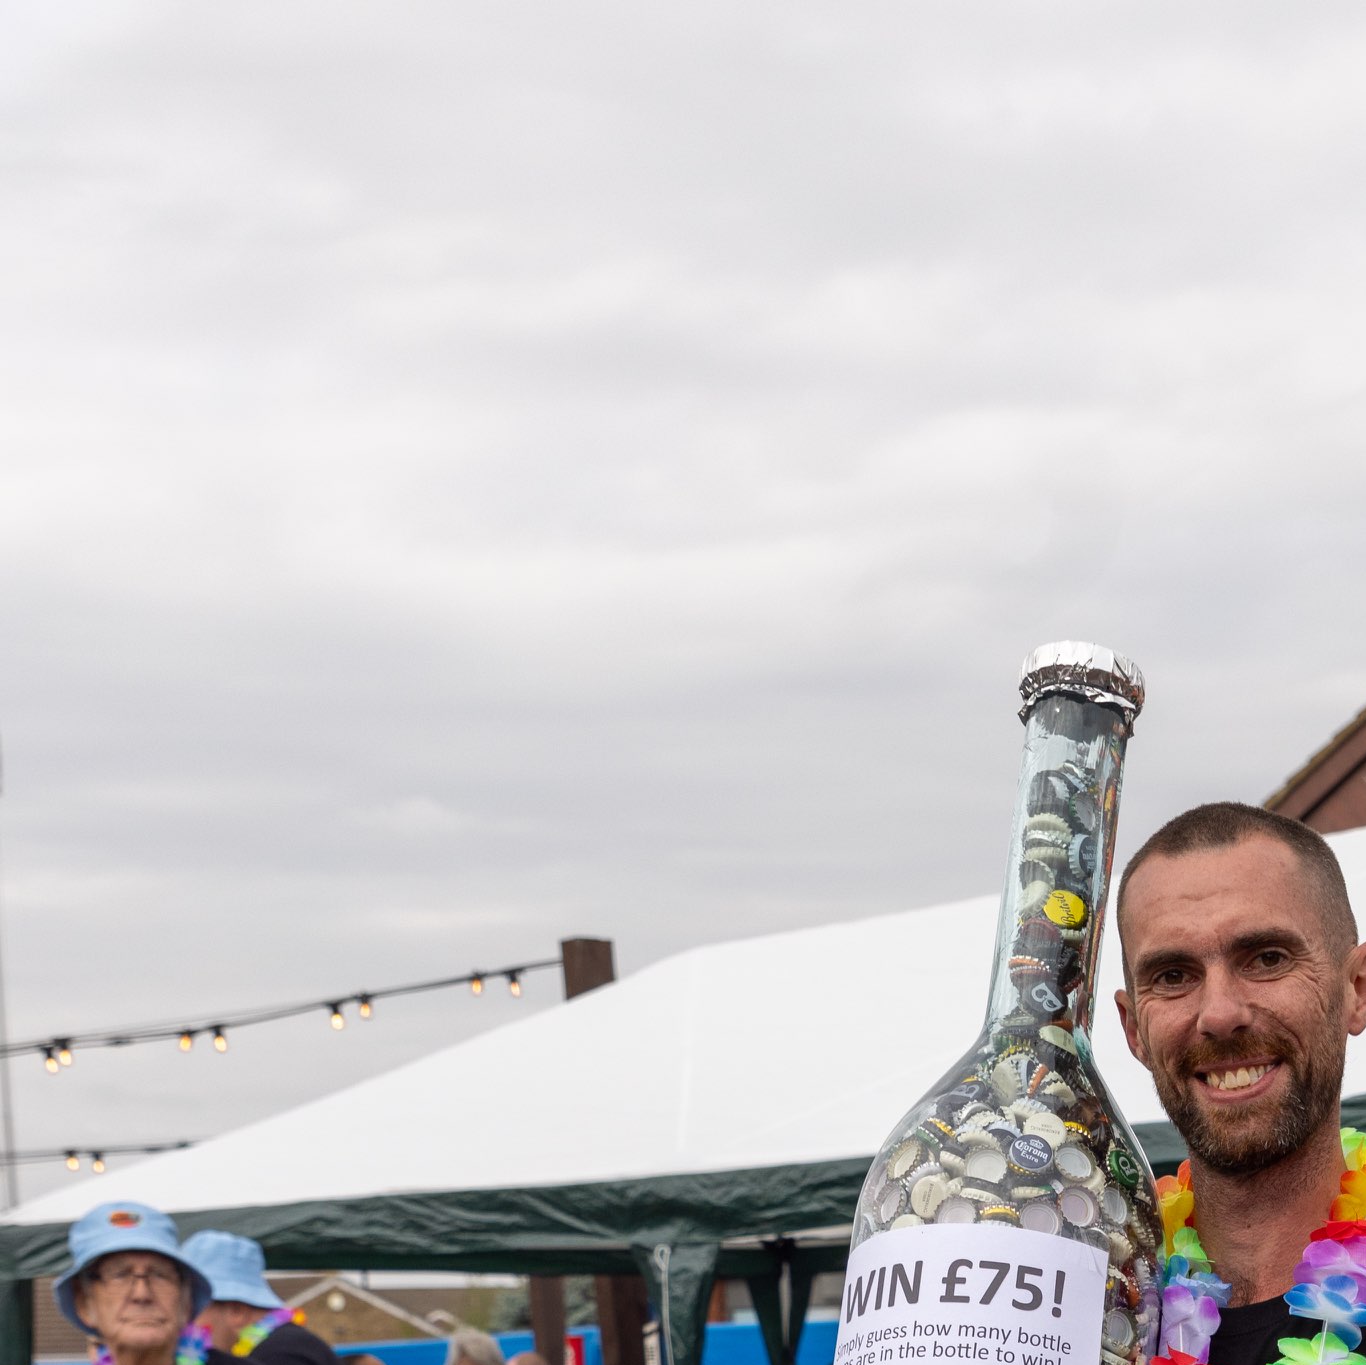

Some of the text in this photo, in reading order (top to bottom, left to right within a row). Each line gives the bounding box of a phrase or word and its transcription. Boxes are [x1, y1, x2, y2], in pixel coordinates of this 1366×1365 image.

[1014, 1139, 1049, 1162] Corona
[845, 1258, 1066, 1325] WIN £75!
[866, 1325, 908, 1349] guess
[912, 1320, 952, 1338] how
[957, 1323, 1012, 1345] many
[1017, 1326, 1072, 1355] bottle
[879, 1346, 893, 1362] in
[898, 1341, 927, 1360] the
[932, 1340, 989, 1360] bottle
[995, 1346, 1016, 1364] to
